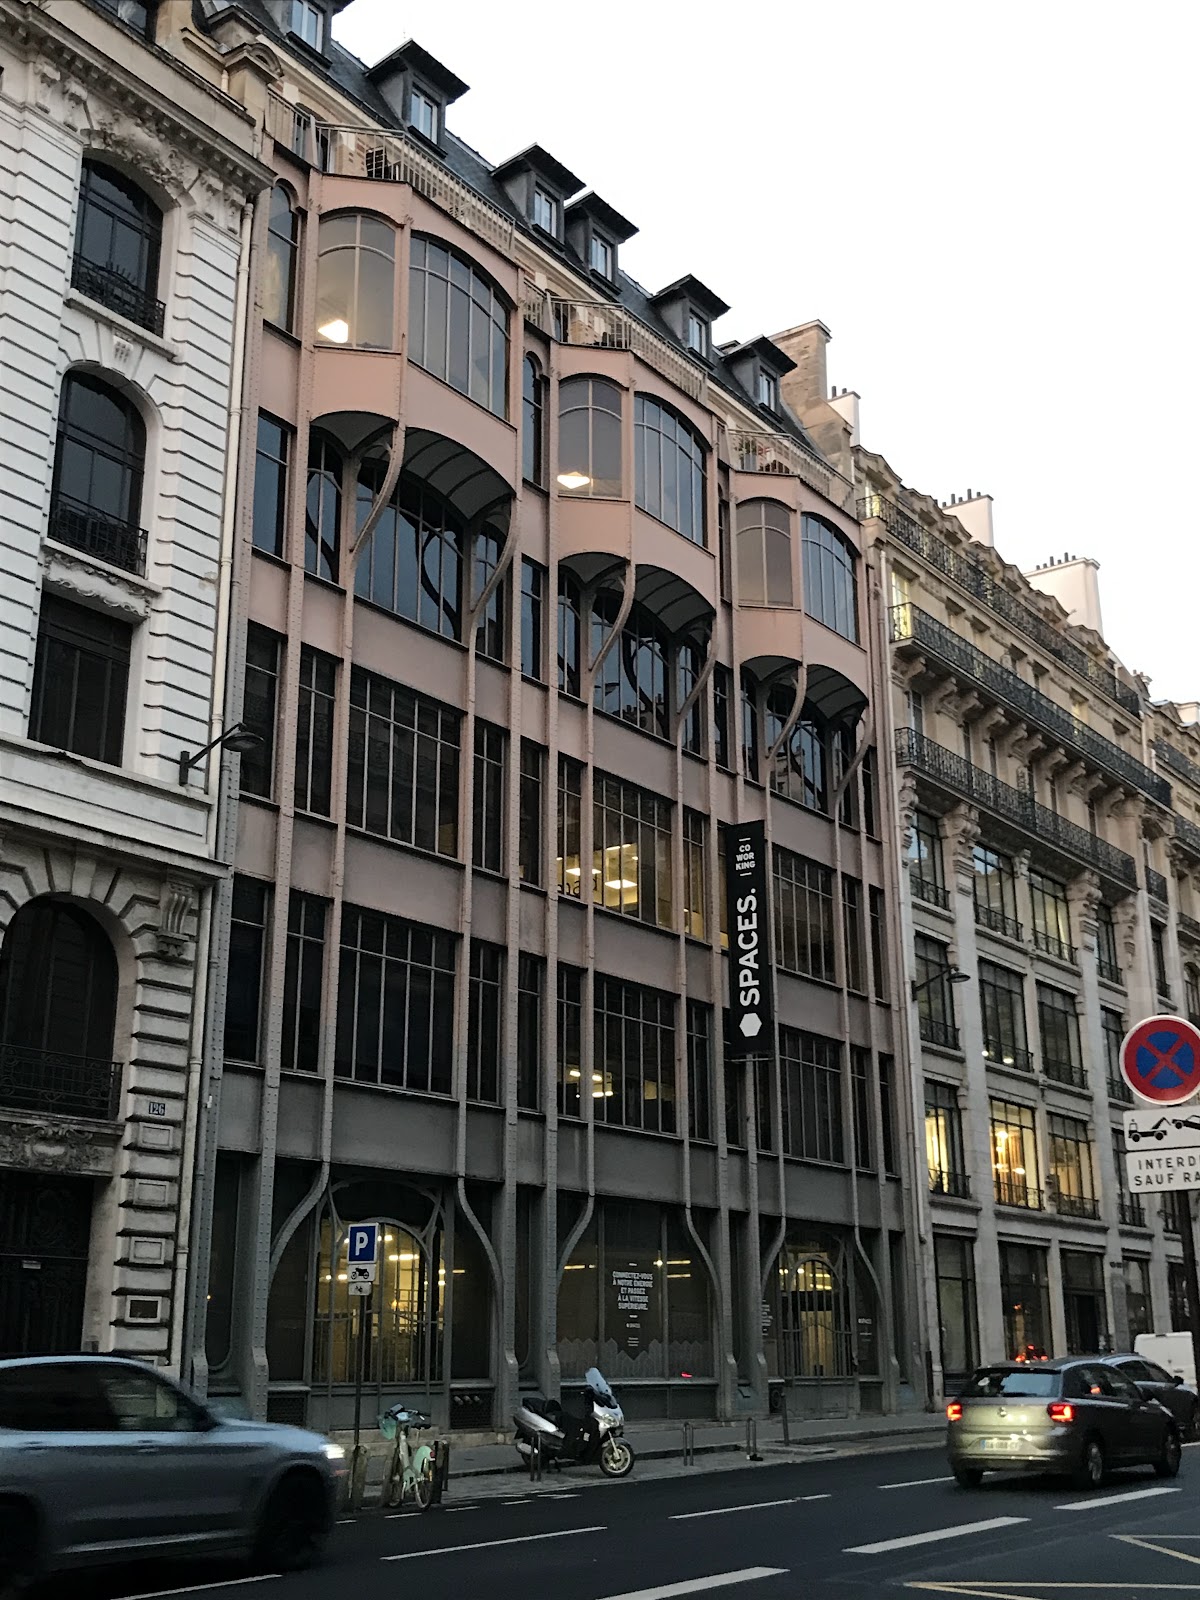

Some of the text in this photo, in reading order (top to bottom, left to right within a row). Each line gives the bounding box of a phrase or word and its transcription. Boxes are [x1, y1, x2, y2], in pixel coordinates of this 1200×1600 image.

[739, 844, 751, 853] CO
[735, 852, 755, 862] WOR
[735, 860, 756, 871] KING
[736, 888, 760, 1007] SPACES.
[150, 1102, 165, 1115] 126
[1133, 1173, 1175, 1187] SAUF
[355, 1231, 369, 1256] P
